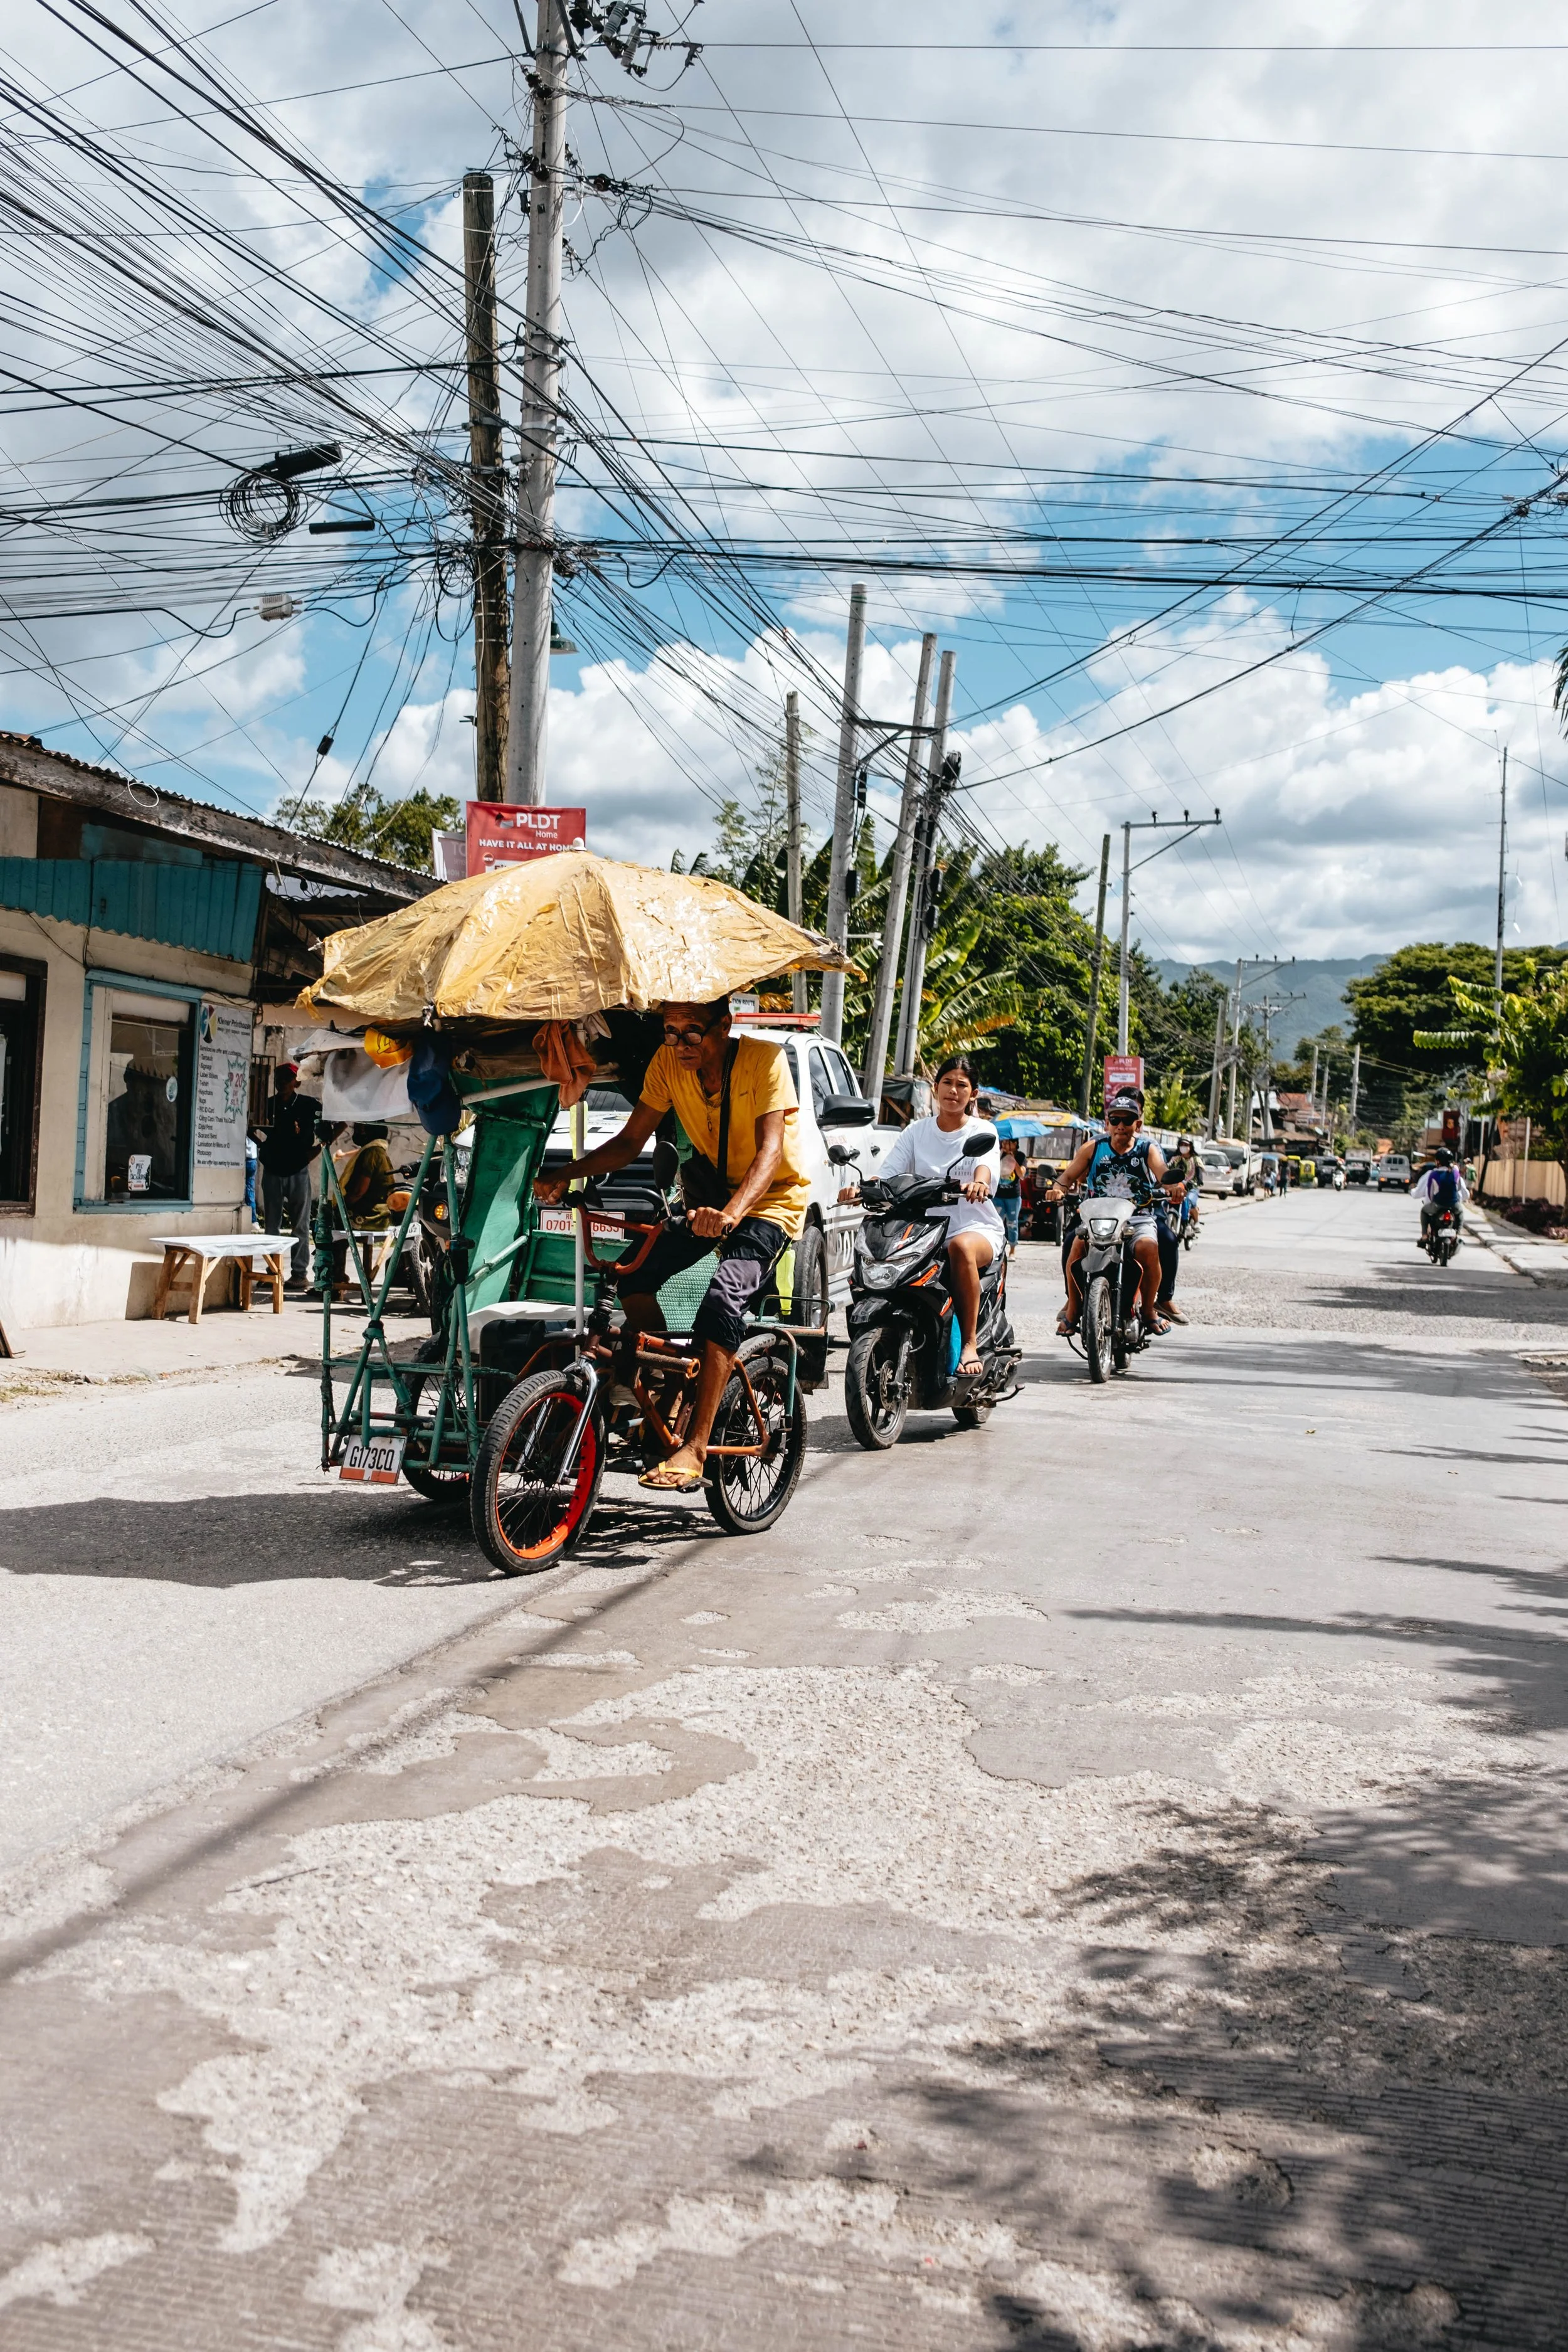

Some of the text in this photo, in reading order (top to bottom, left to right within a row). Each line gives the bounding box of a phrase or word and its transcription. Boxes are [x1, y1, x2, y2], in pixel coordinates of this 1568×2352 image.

[517, 812, 561, 830] PLDT
[479, 839, 504, 848] HAVE
[517, 842, 534, 850] ALL
[218, 1017, 231, 1026] Kleiner
[235, 1073, 243, 1088] 20
[349, 1446, 395, 1471] G173CQ
